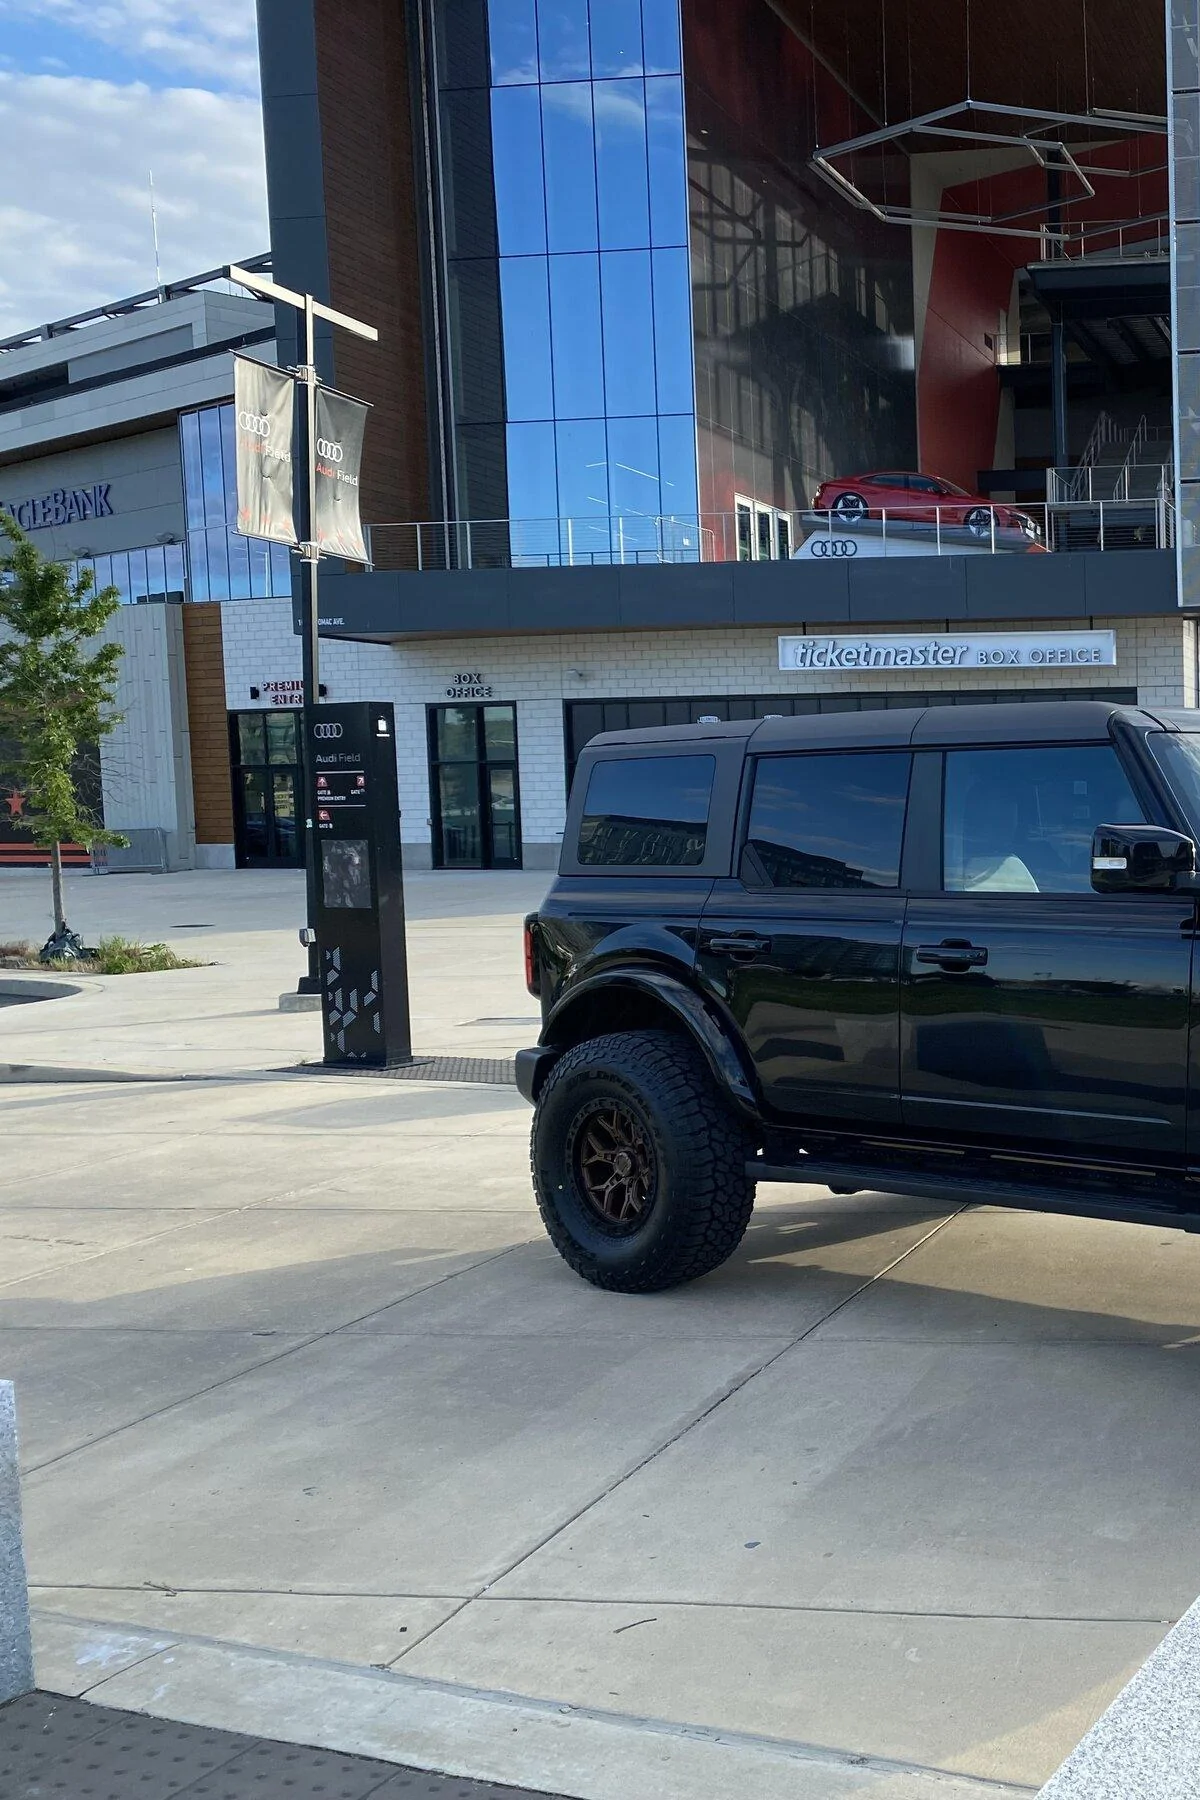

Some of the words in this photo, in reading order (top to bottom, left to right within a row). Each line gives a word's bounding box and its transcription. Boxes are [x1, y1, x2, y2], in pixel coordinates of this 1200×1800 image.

[265, 443, 290, 462] Field
[316, 462, 335, 477] Audi
[337, 469, 358, 486] Field
[794, 640, 968, 667] ticketmaster
[976, 650, 1019, 664] BOX
[1028, 648, 1101, 664] OFFICE
[453, 673, 481, 684] BOX
[262, 681, 304, 691] PREMIU
[446, 686, 491, 698] OFFICE
[271, 694, 302, 704] ENTR
[315, 754, 337, 763] Audi
[339, 753, 361, 762] Field
